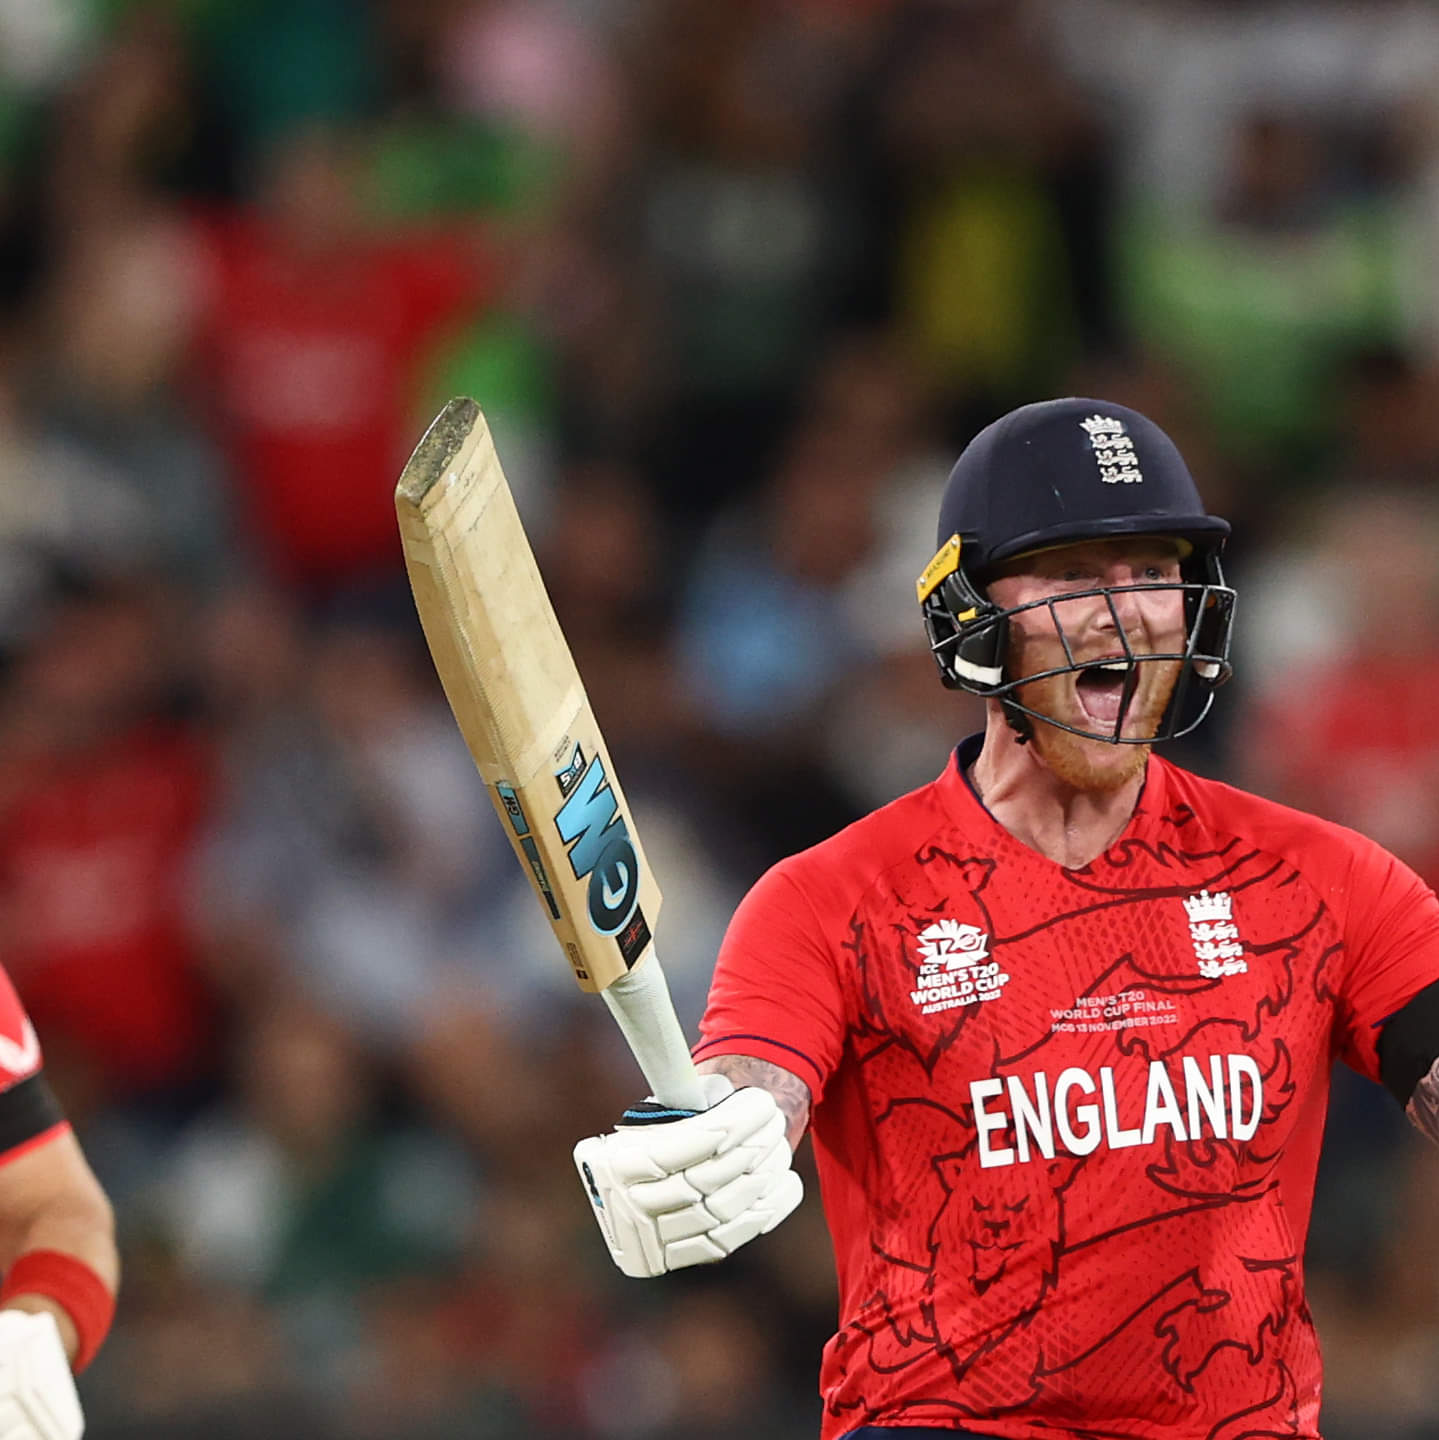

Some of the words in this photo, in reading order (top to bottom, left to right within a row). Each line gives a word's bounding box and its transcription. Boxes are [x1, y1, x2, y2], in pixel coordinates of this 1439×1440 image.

[554, 752, 640, 936] GM
[917, 969, 969, 989] MEN'S
[969, 962, 1000, 979] T20
[920, 964, 940, 975] ICC
[910, 981, 974, 1005] WORLD
[975, 973, 1010, 991] CUP
[1076, 996, 1117, 1008] MEN'S
[1118, 991, 1145, 1003] T20
[1050, 1007, 1101, 1020] WORLD
[1103, 1003, 1131, 1017] CUP
[1133, 999, 1177, 1013] FINAL
[1088, 1016, 1149, 1033] NOVEMBER
[970, 1053, 1264, 1168] ENGLAND
